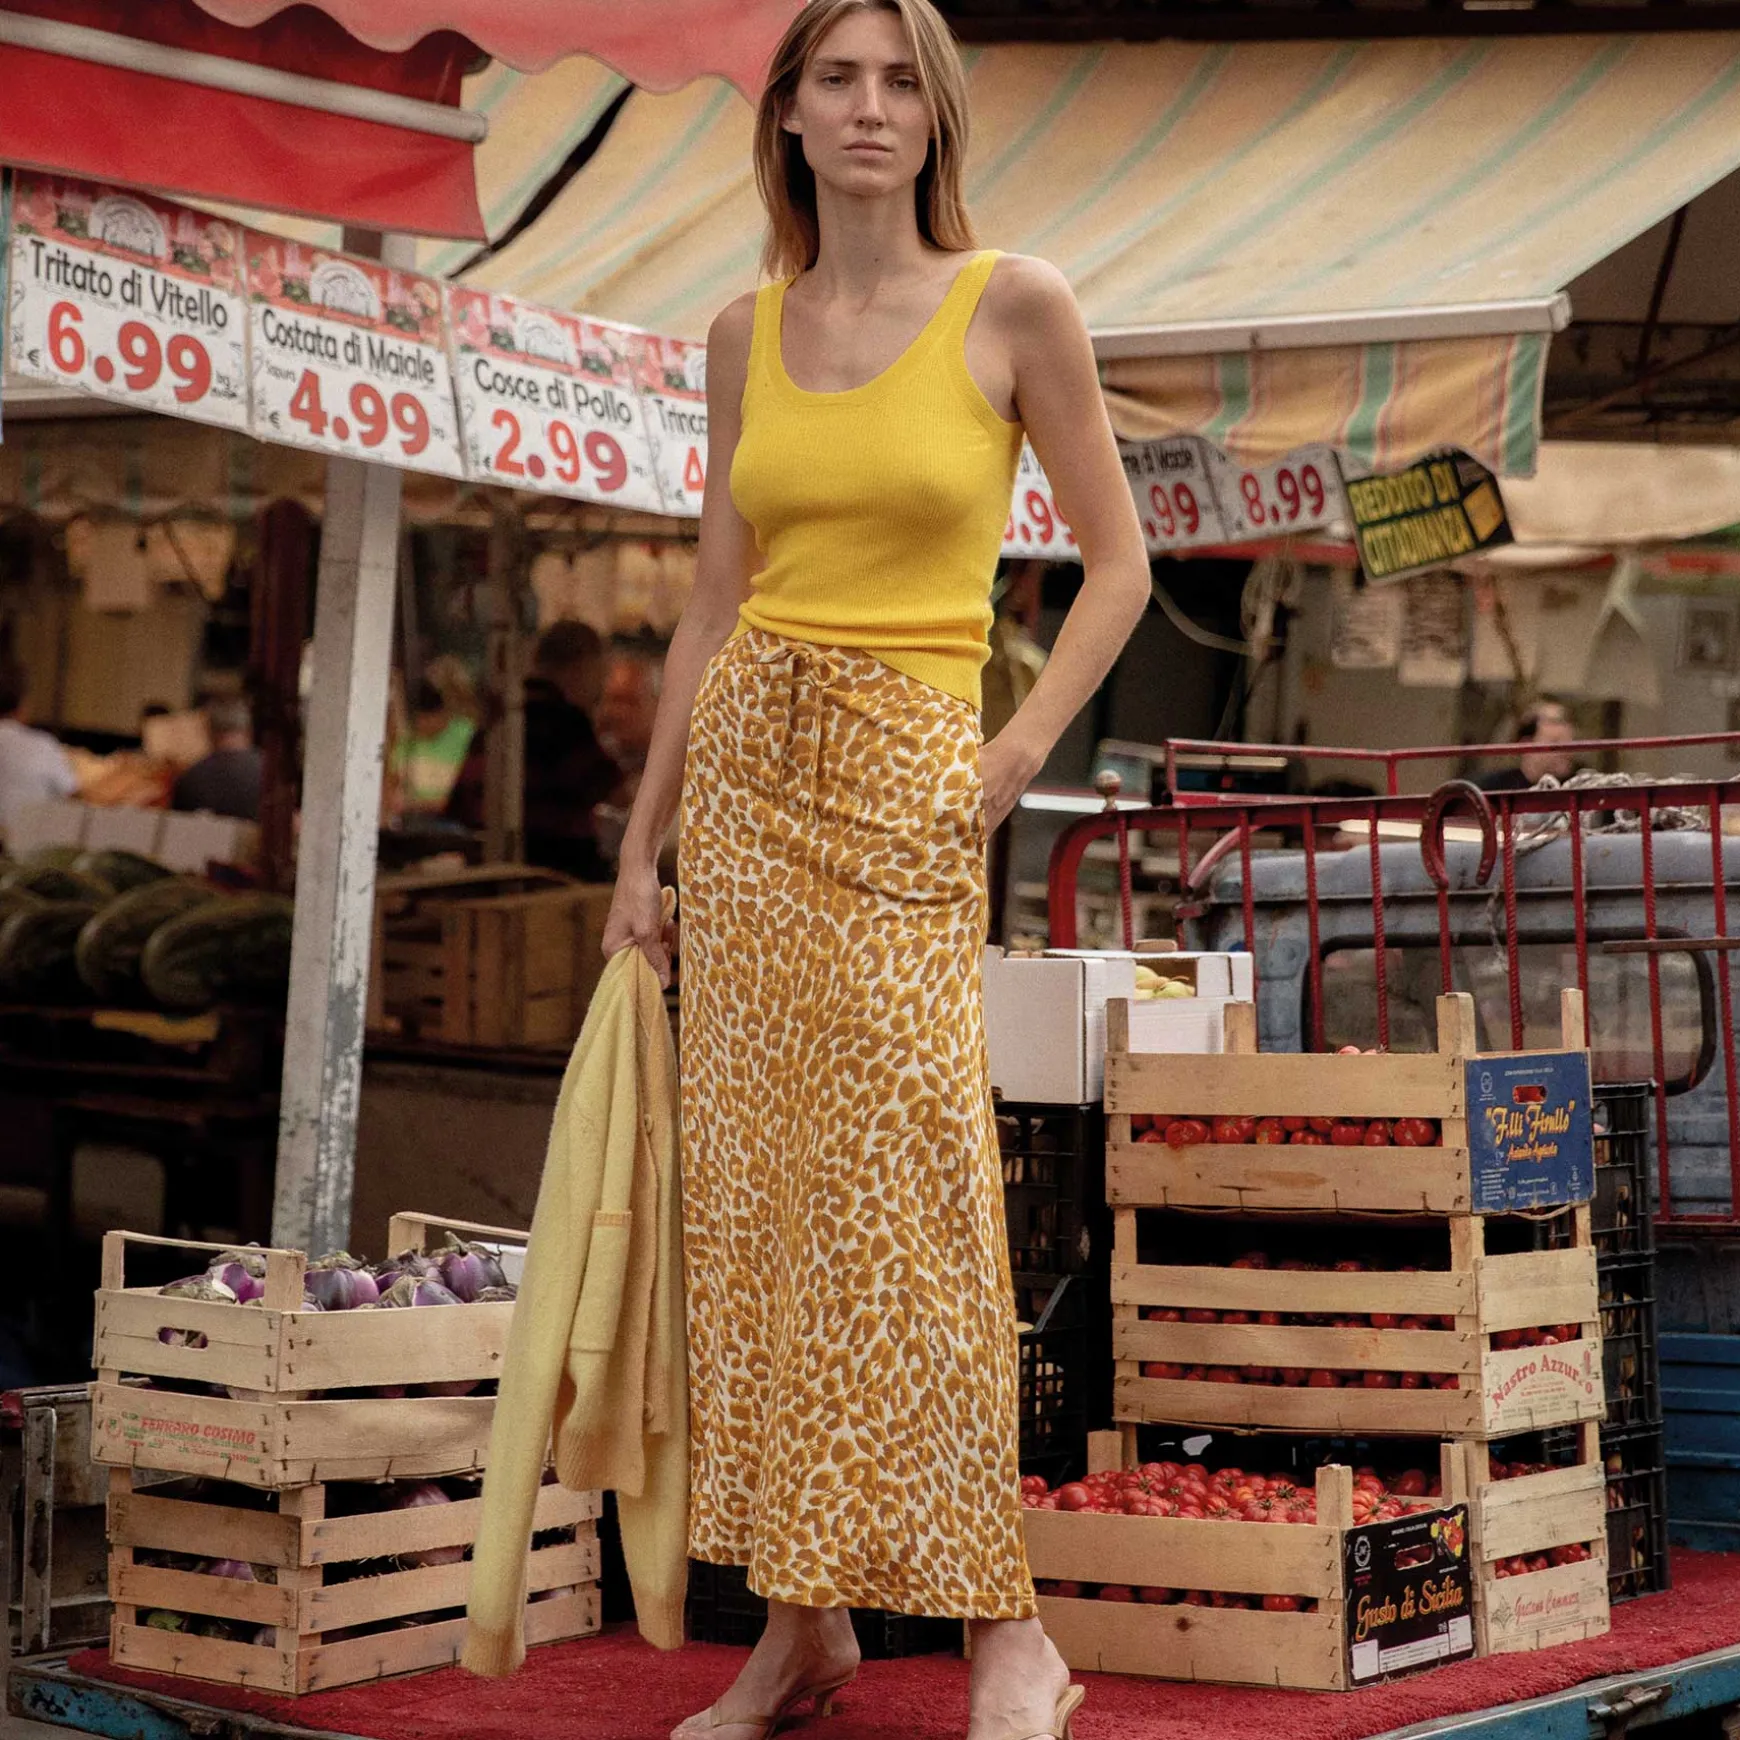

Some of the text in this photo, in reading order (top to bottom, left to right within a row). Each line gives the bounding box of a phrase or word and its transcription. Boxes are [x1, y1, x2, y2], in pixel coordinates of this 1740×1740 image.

[30, 240, 228, 328] Tritato di Vitello
[48, 300, 212, 403] 6.99
[262, 308, 435, 384] Costata di Maiale
[290, 368, 430, 456] 4.99
[474, 358, 632, 424] Cosce di Pollo
[491, 409, 628, 492] 2.99
[1240, 464, 1325, 526] 8.99
[1492, 1361, 1537, 1409] Nastro
[141, 1417, 200, 1435] FERRARO
[204, 1425, 256, 1444] COSIMO
[1355, 1574, 1465, 1642] Gusto di Sicilia
